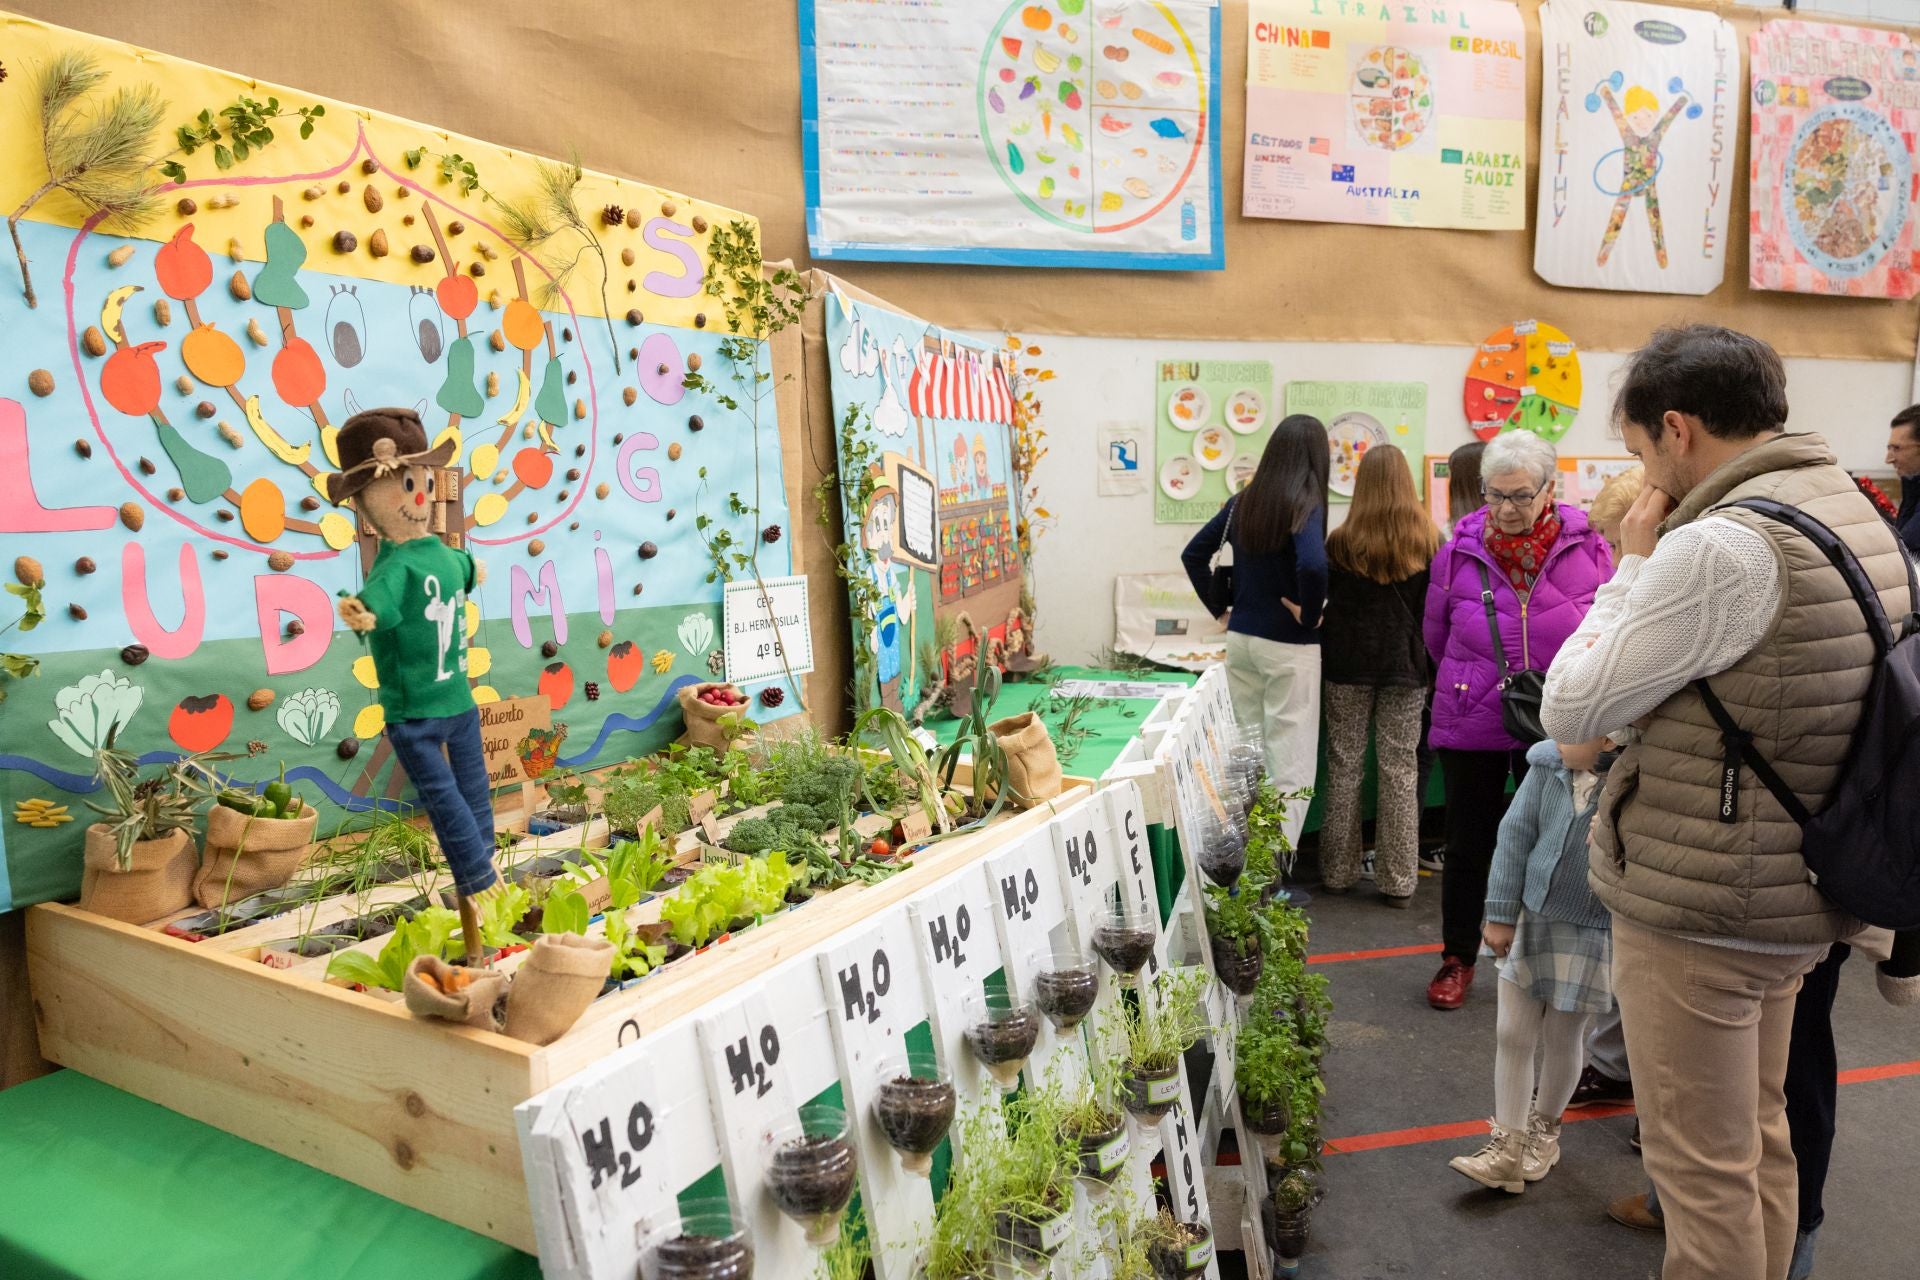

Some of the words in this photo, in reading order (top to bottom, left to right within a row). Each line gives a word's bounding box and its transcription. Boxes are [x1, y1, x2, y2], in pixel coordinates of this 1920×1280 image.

[1255, 22, 1310, 48] CHINA
[1472, 37, 1521, 60] BRASIL
[1250, 133, 1303, 150] ESTADOS
[1553, 43, 1571, 228] HEALTHY
[1703, 29, 1727, 258] LIFESTYLE
[1254, 154, 1292, 164] UNIDOS
[1464, 150, 1521, 169] ARABIA
[1464, 169, 1514, 187] SAUDI
[1346, 185, 1420, 200] AUSTRALIA
[756, 596, 775, 609] CEP
[734, 621, 748, 634] B.J.
[774, 641, 783, 657] B
[480, 704, 524, 727] Huerto
[1722, 767, 1736, 816] Quechua
[1066, 829, 1097, 886] H2O
[1001, 868, 1039, 921] H2O
[929, 904, 971, 969] H2O
[838, 949, 891, 1024] H2O
[725, 1024, 781, 1098] H2O
[582, 1101, 654, 1190] H2O
